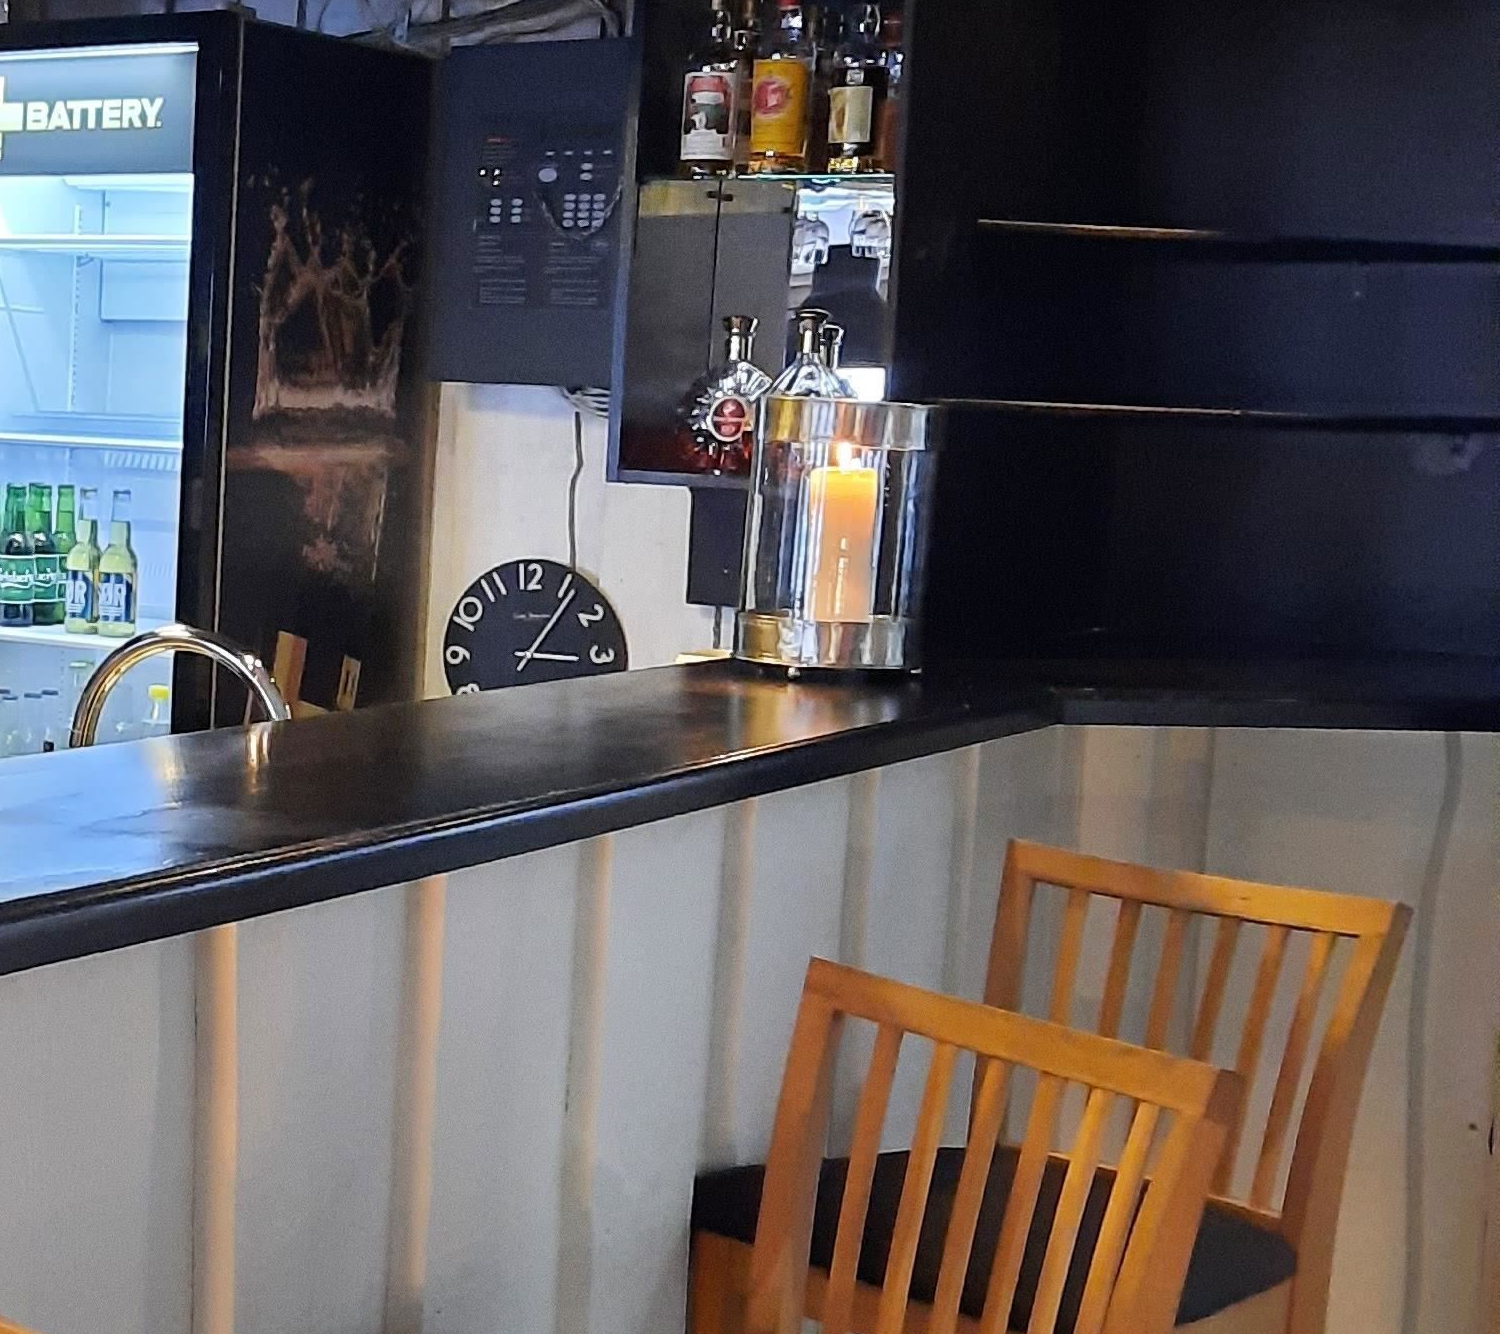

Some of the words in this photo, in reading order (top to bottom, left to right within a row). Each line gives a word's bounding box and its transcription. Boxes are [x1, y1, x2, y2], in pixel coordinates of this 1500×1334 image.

[480, 571, 508, 603] 11
[518, 562, 544, 591] 12
[557, 573, 572, 599] 1
[452, 596, 484, 633] 10
[577, 603, 605, 628] 2
[445, 645, 471, 665] 9
[589, 644, 615, 665] 3
